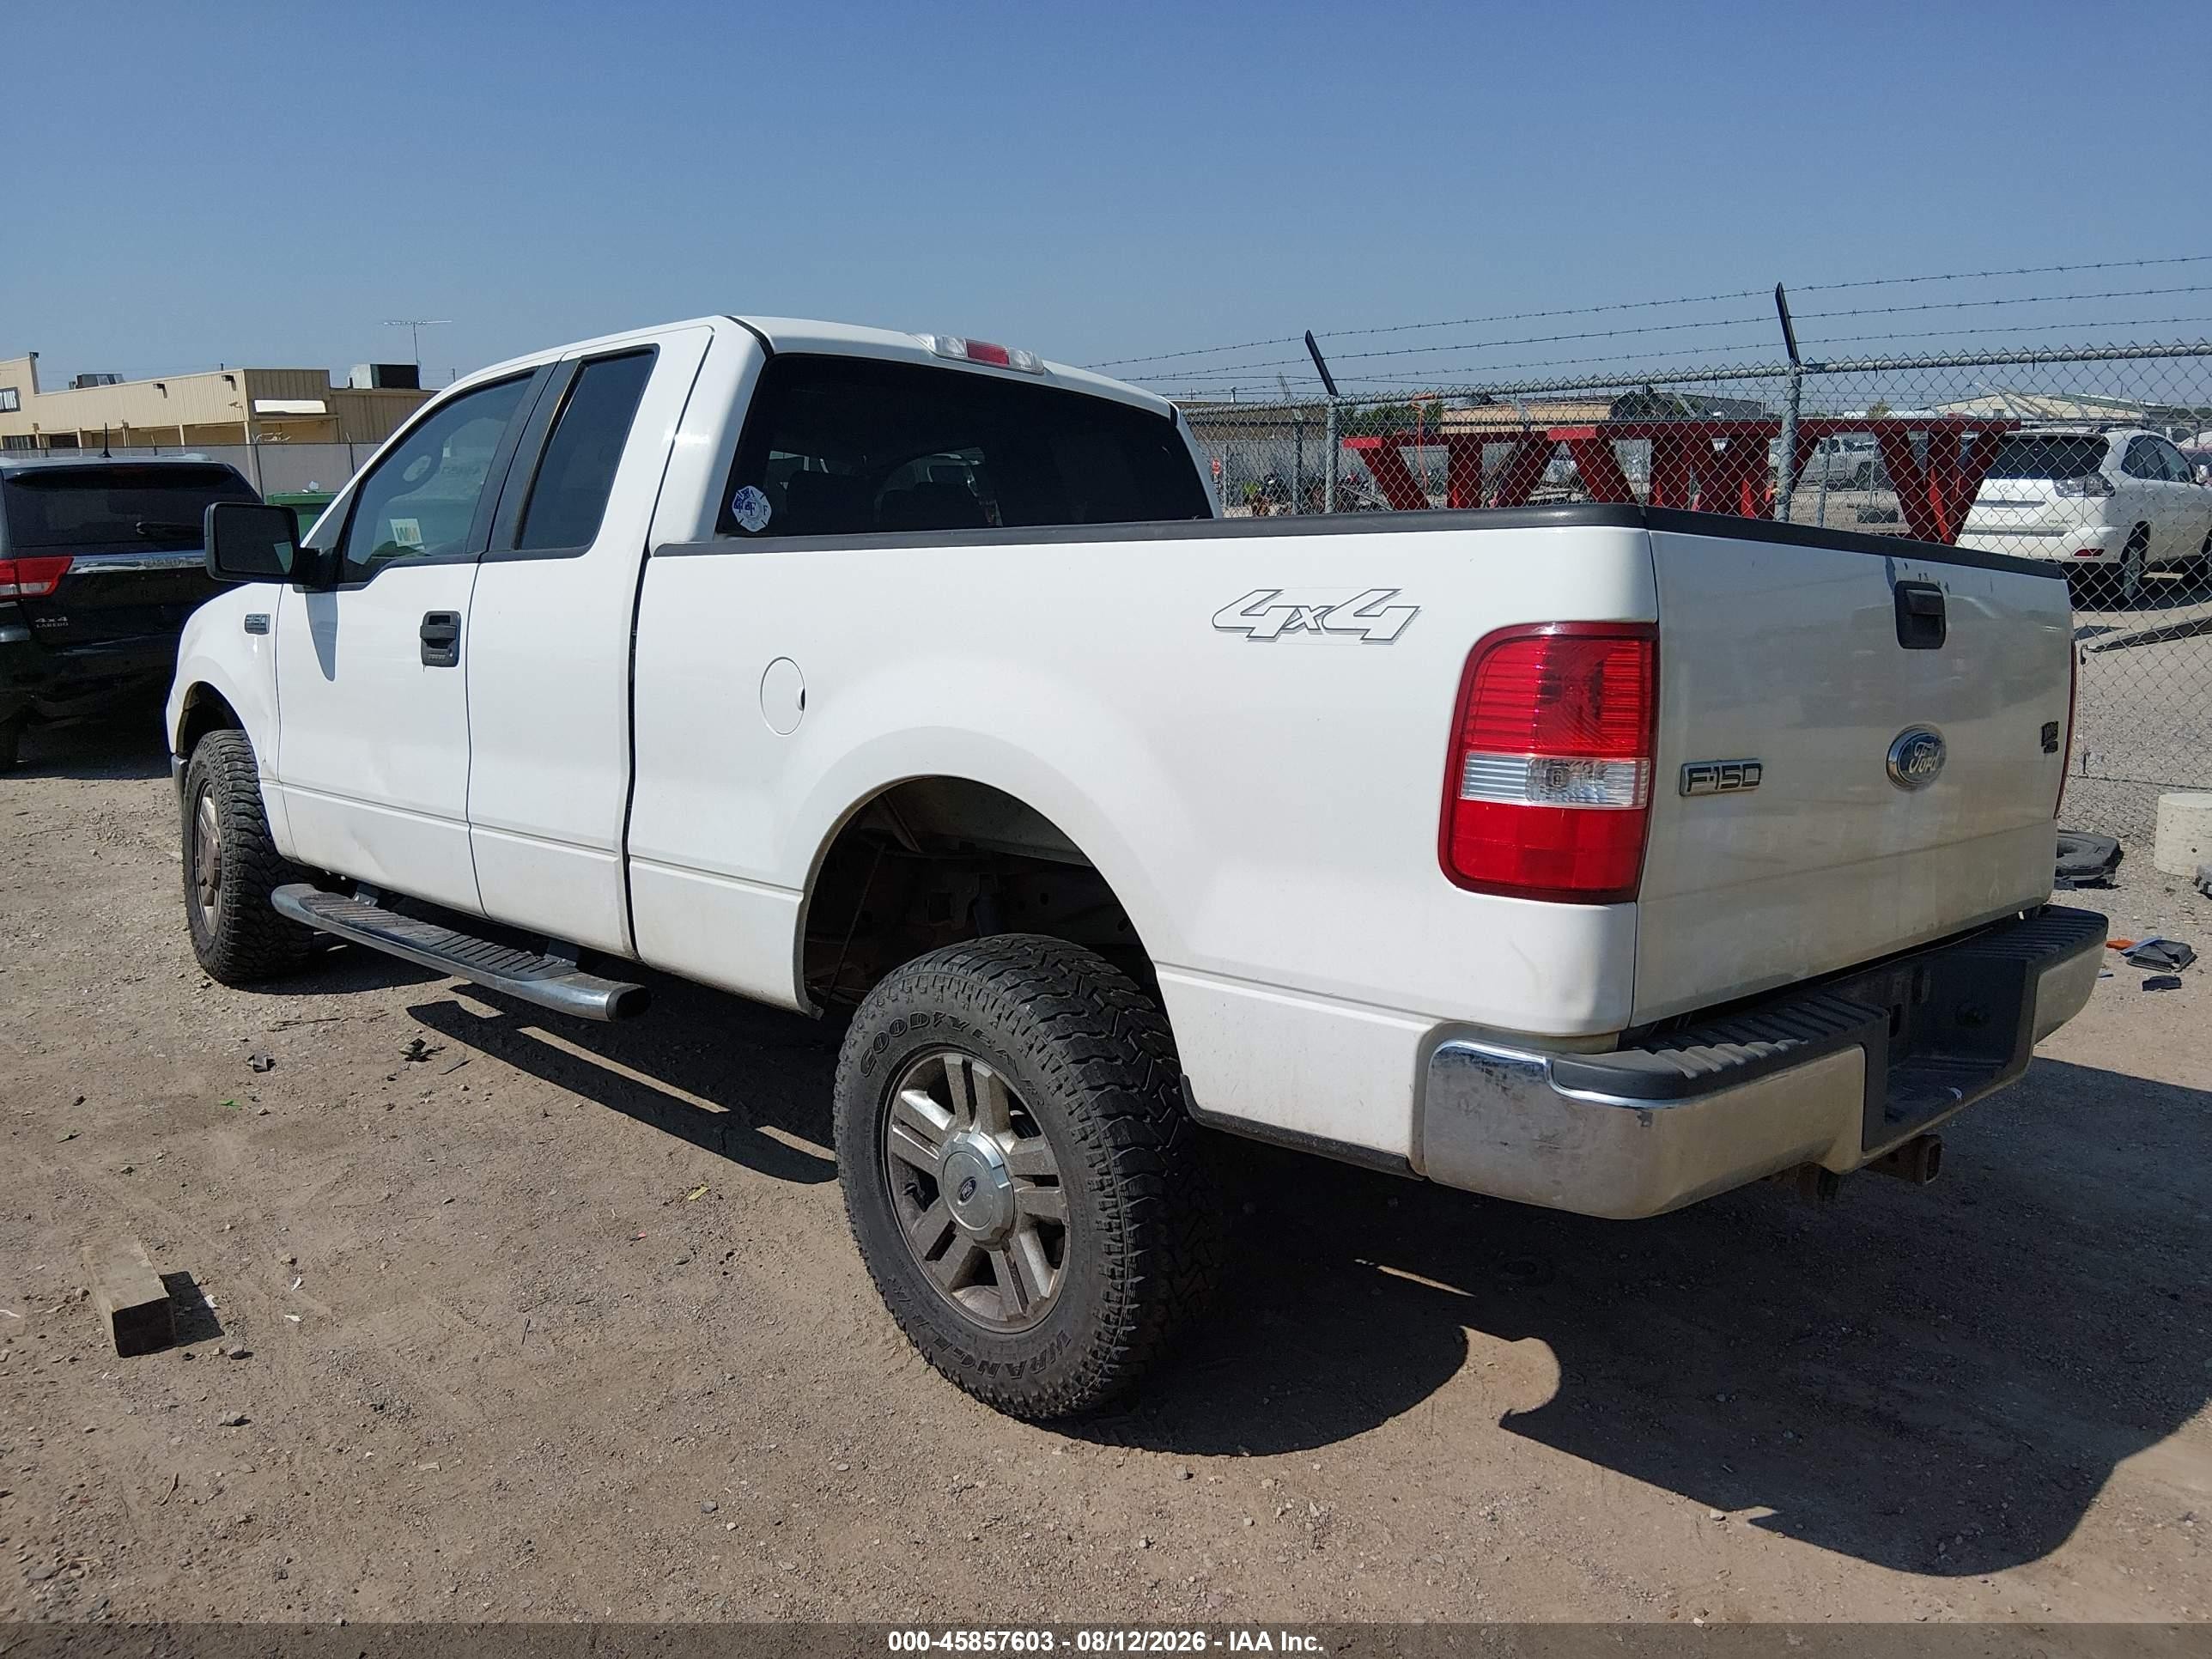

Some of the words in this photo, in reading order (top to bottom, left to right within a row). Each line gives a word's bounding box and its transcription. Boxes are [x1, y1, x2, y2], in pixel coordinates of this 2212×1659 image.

[1212, 588, 1422, 645] 4x4
[1908, 741, 1941, 774] Ford
[1686, 763, 1762, 793] F-150
